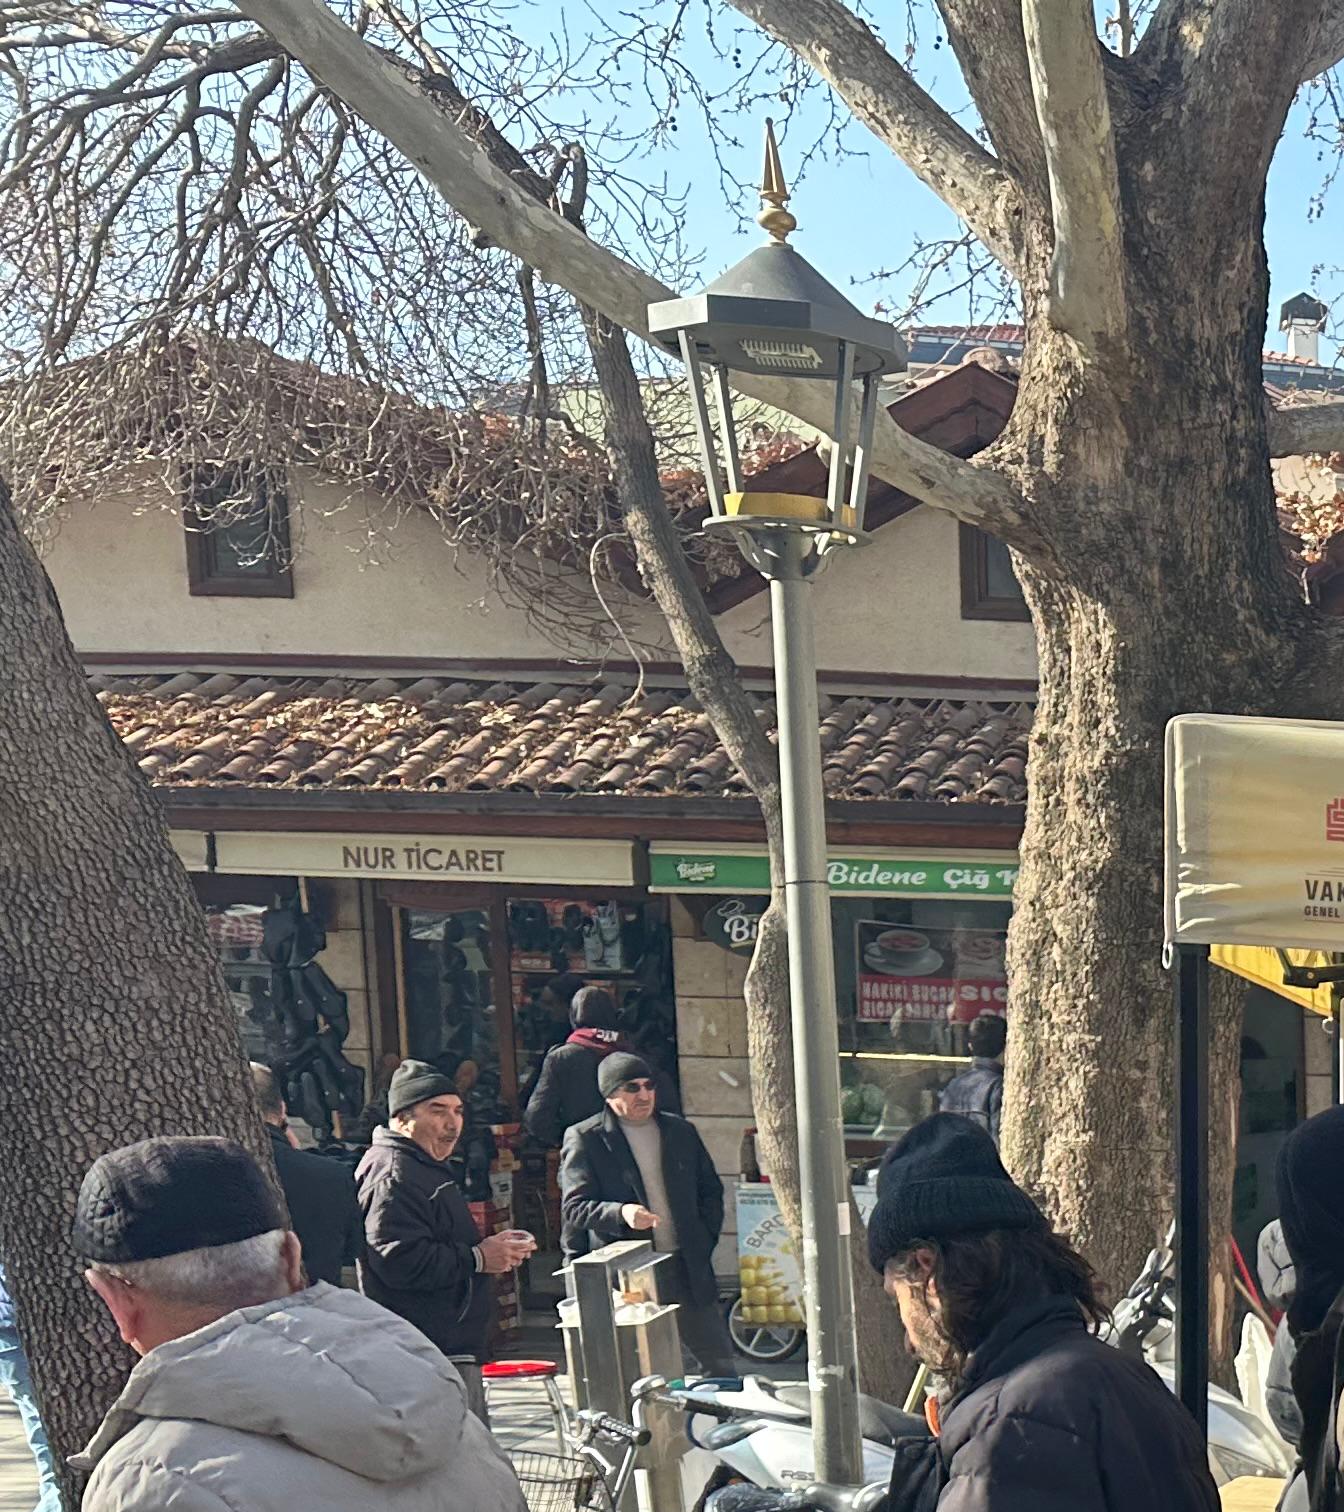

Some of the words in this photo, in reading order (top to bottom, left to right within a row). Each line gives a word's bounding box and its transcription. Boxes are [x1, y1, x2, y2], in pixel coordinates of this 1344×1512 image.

[342, 846, 396, 869] NUR
[403, 842, 505, 872] TİCARET
[828, 862, 927, 885] Bidene
[943, 868, 990, 889] Çiğ
[1304, 905, 1340, 918] GENEL
[723, 915, 758, 942] Bi
